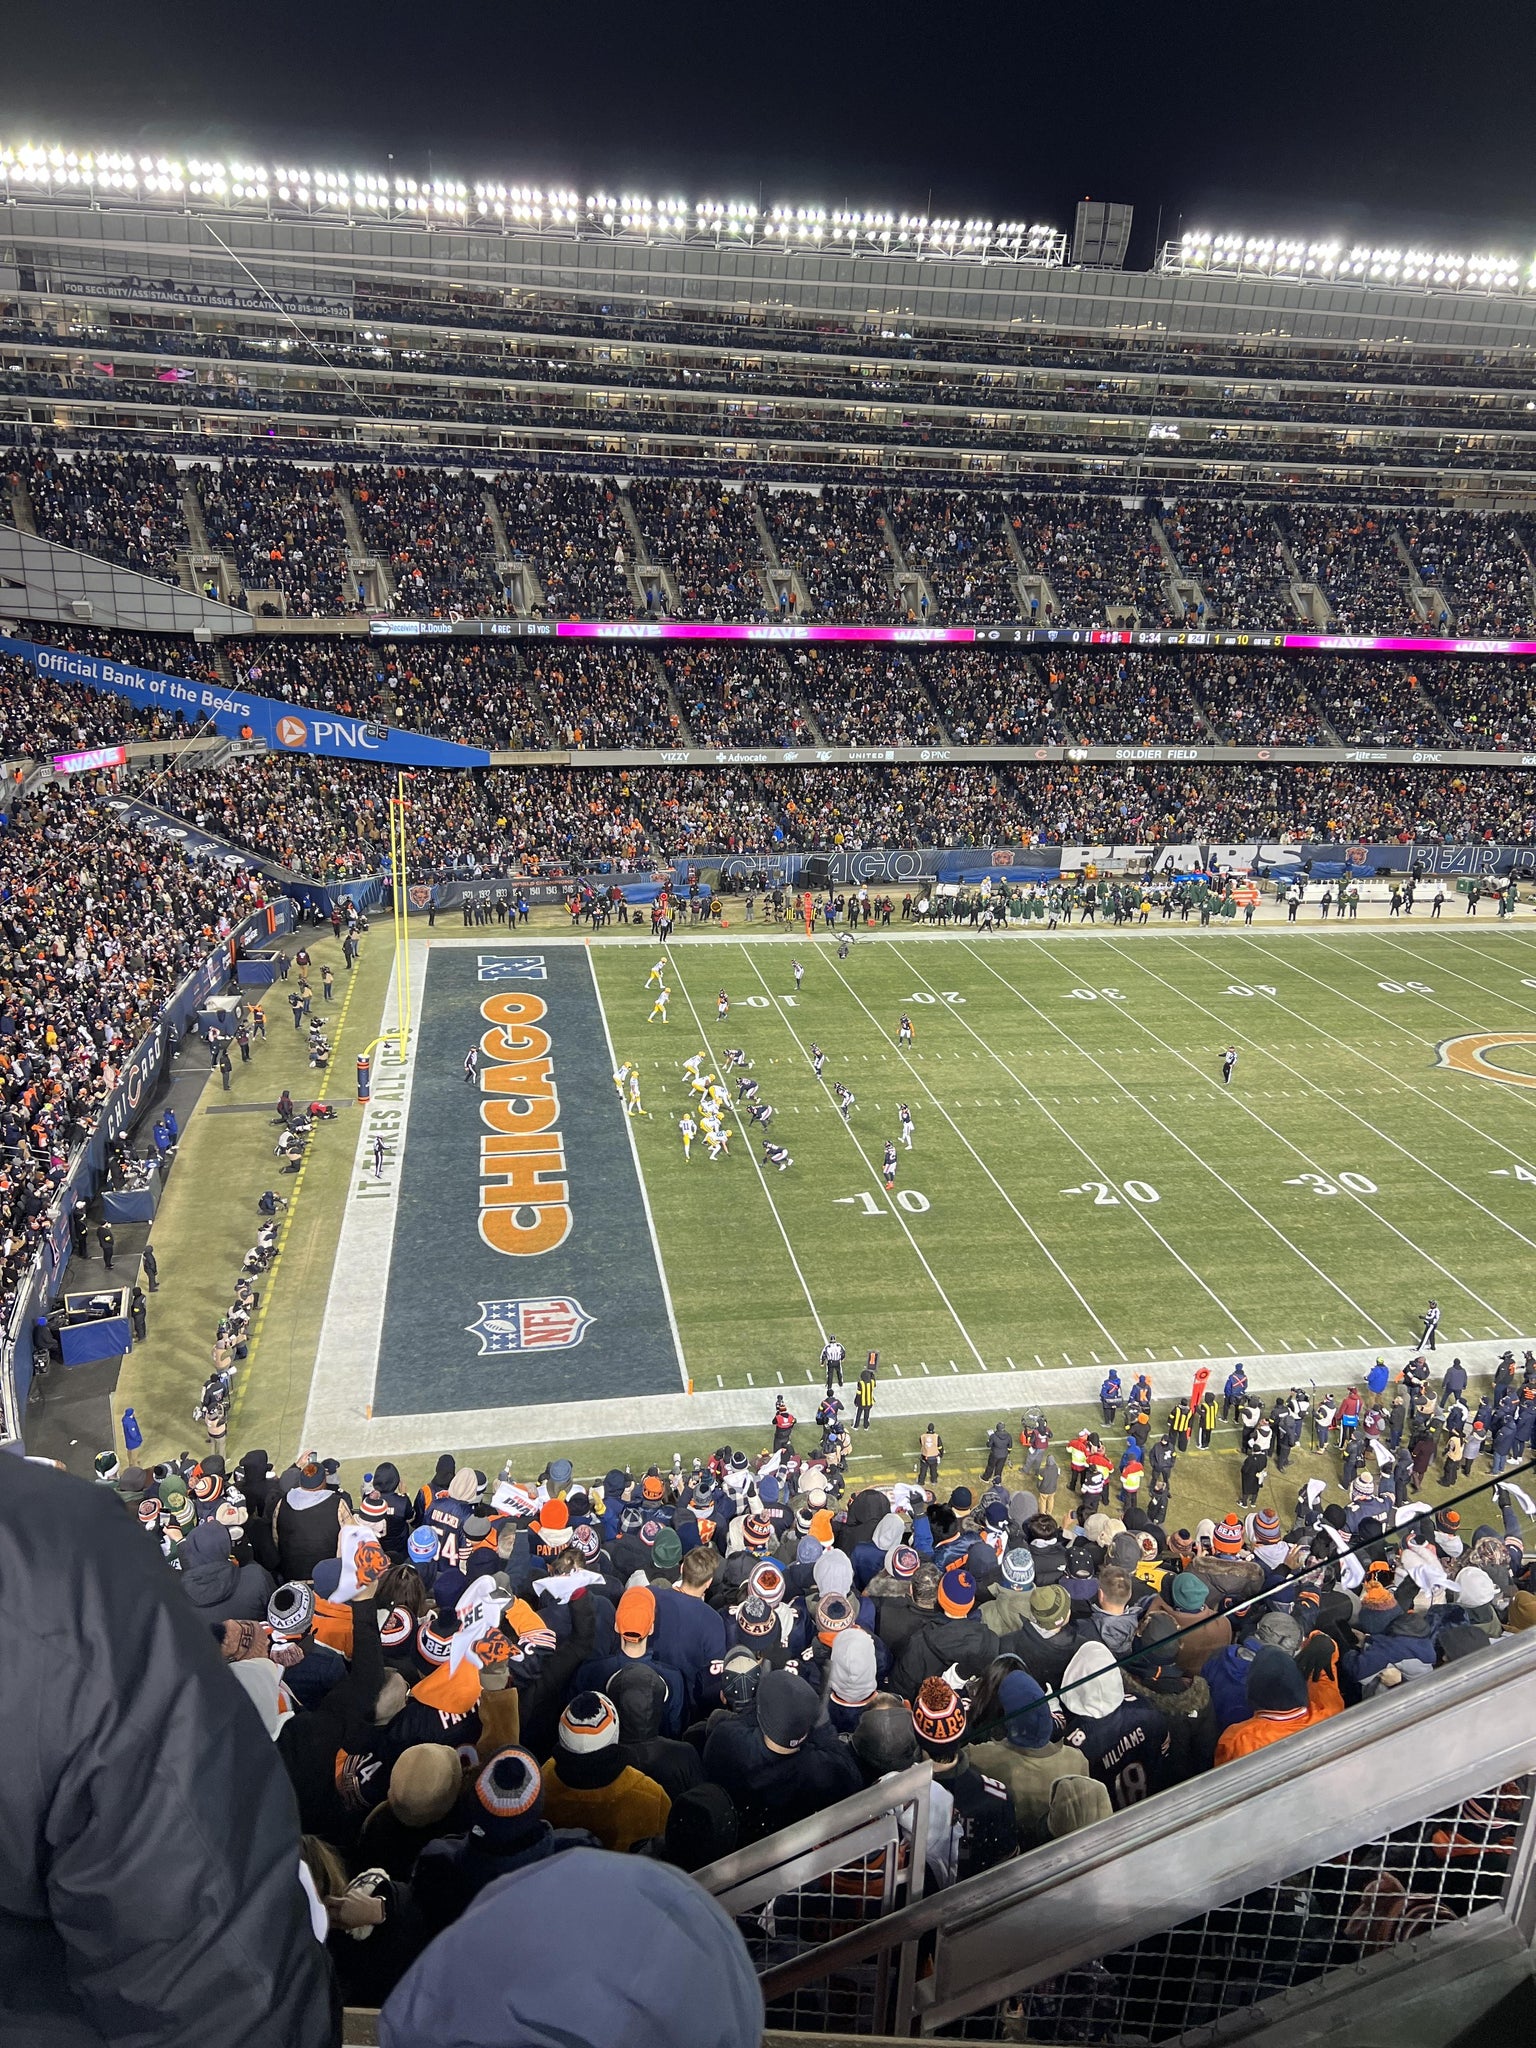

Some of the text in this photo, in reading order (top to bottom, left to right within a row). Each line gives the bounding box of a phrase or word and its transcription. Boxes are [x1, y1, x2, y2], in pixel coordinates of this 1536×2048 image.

[64, 283, 83, 293] FOR
[85, 286, 185, 302] SECURITY/ASSISTANCE
[186, 294, 208, 304] TEXT
[209, 297, 233, 306] ISSUE
[242, 300, 283, 310] LOCATION
[285, 303, 296, 312] TO
[421, 623, 452, 633] R.Doubs
[491, 624, 497, 634] 4
[498, 625, 511, 634] REC
[528, 624, 536, 634] 51
[537, 625, 550, 635] YDS
[1014, 630, 1021, 641] 3
[1073, 631, 1080, 642] 0
[1139, 633, 1161, 643] 9:34
[1178, 633, 1186, 644] 2
[1237, 635, 1249, 645] 10
[1274, 636, 1281, 646] 5
[38, 652, 250, 717] Official Bank of the Bears
[310, 721, 379, 749] PNC
[64, 749, 118, 773] WAVE
[660, 753, 690, 761] VIZZY
[728, 753, 767, 762] Advocate
[931, 751, 951, 760] PNC
[1116, 750, 1198, 759] SOLDIER FIELD
[1423, 754, 1442, 762] PNC
[1407, 846, 1501, 874] BEAR
[462, 890, 473, 900] 1921
[1071, 988, 1127, 1001] 30
[1227, 985, 1278, 997] 40
[1377, 981, 1435, 994] 50
[746, 995, 800, 1008] 10
[911, 991, 967, 1004] 20
[108, 1037, 161, 1140] CHICAGO
[374, 1073, 407, 1101] ALL
[478, 992, 573, 1257] CHICAGO
[362, 1110, 402, 1170] TAKES
[1299, 1171, 1378, 1195] 30
[1514, 1164, 1536, 1185] 4
[356, 1181, 392, 1199] IT
[1081, 1180, 1162, 1206] 20
[854, 1189, 931, 1215] 10
[523, 1301, 571, 1346] NFL
[753, 1524, 772, 1534] BEAR
[426, 1638, 452, 1656] BEA
[916, 1708, 965, 1739] BEARS
[1066, 1727, 1087, 1746] 18
[1102, 1726, 1146, 1770] WILLIAMS
